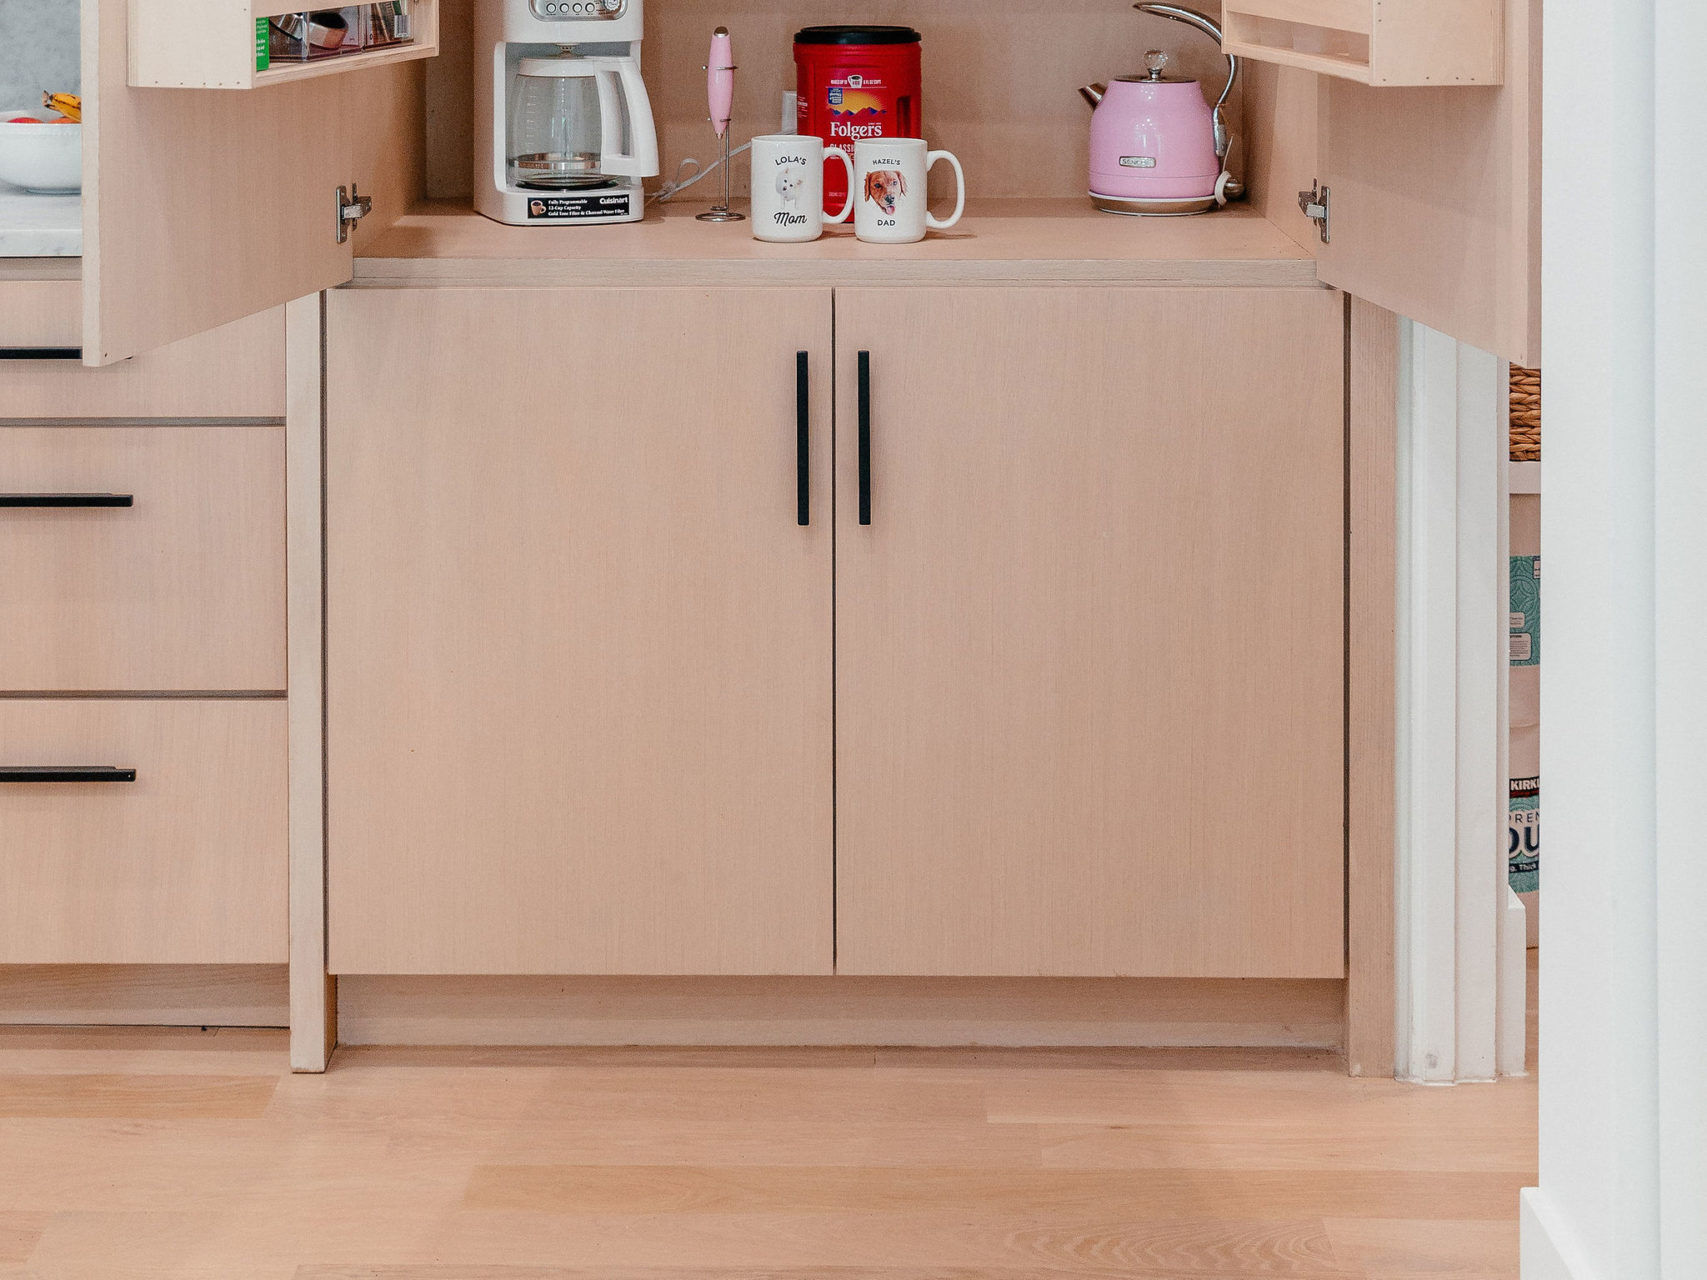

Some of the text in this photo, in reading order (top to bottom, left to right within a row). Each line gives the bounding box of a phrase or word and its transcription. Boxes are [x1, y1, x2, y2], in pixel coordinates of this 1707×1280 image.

[830, 121, 882, 141] Folgers
[775, 155, 807, 166] LOLA'S
[872, 158, 901, 166] HAZEL'S
[599, 196, 628, 205] Cuisinart
[773, 212, 807, 227] Mom
[877, 219, 896, 227] DAD
